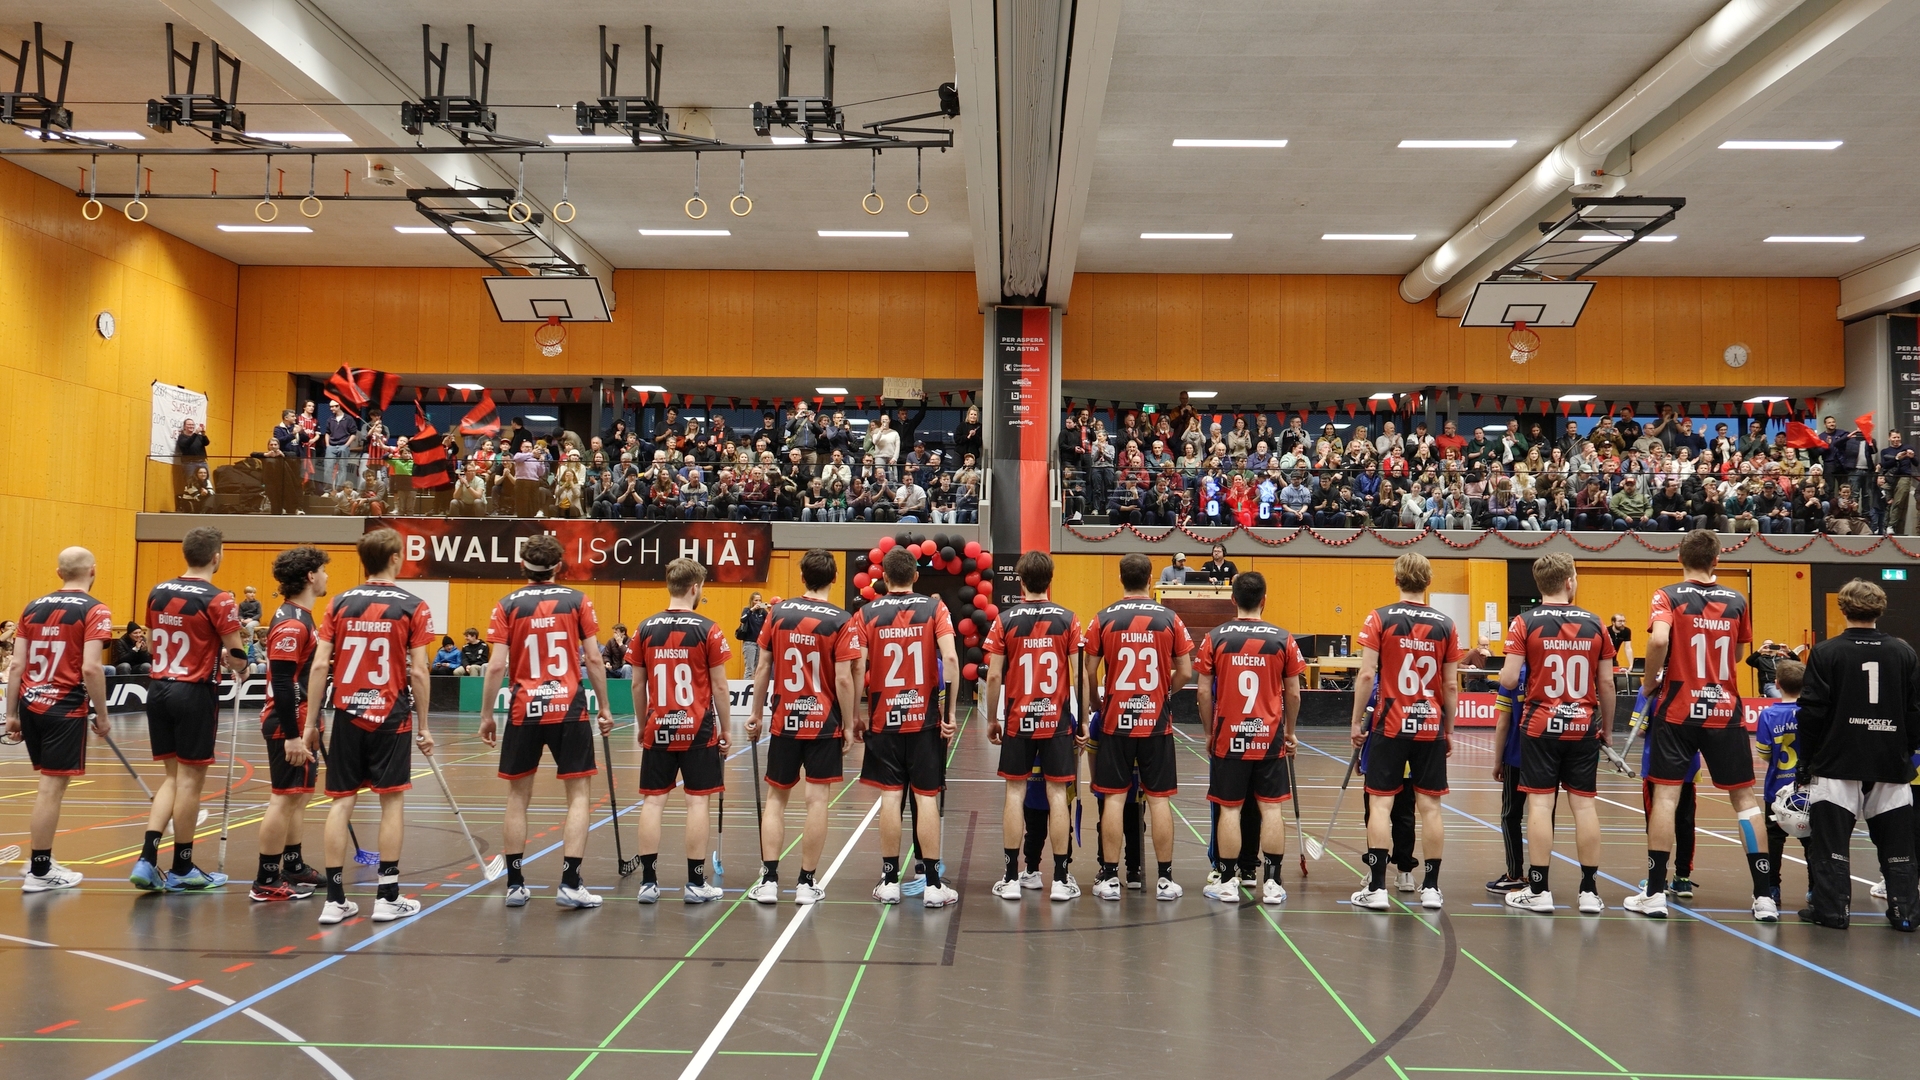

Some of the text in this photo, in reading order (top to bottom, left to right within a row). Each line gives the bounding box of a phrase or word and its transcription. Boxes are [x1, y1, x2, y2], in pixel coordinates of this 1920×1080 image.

[406, 530, 754, 566] BWALD ISCH HIÄ!
[157, 583, 207, 594] UNIHOC
[342, 589, 410, 600] UNIHOC
[510, 588, 572, 600] UNIHOC
[1677, 587, 1736, 598] UNIHOC
[36, 596, 88, 605] UNIHOC
[872, 596, 928, 608] UNIHOC
[781, 602, 840, 616] UNIHOC
[1010, 607, 1064, 617] UNIHOC
[1107, 603, 1165, 613] UNIHOC
[1533, 610, 1591, 618] UNIHOC
[158, 612, 183, 626] BÜRGE
[646, 616, 703, 626] UNIHOC
[1388, 608, 1445, 622] UNIHOC
[531, 617, 556, 628] MUFF
[880, 626, 923, 638] ODERMATT
[1220, 625, 1278, 635] UNIHOC
[789, 633, 816, 646] HOFER
[1024, 638, 1052, 648] FURRER
[1121, 631, 1154, 643] PLUHAŘ
[152, 628, 190, 675] 32
[1543, 640, 1592, 651] BACHMANN
[524, 631, 568, 679] 15
[654, 648, 689, 660] JANSSON
[1691, 634, 1730, 680] 11
[29, 640, 66, 682] 57
[342, 637, 390, 686] 73
[884, 641, 924, 687] 21
[1232, 654, 1265, 667] KUČERA
[784, 647, 822, 693] 31
[1019, 652, 1058, 695] 13
[1115, 647, 1158, 692] 23
[1399, 653, 1437, 697] 62
[1544, 655, 1589, 699] 30
[1862, 662, 1879, 704] 1
[654, 663, 694, 707] 18
[1238, 670, 1259, 714] 9
[543, 703, 569, 712] BÜRGI
[1454, 700, 1495, 718] iliar
[1708, 707, 1733, 717] BÜRGI
[901, 712, 926, 722] BÜRGI
[1134, 718, 1156, 726] BÜRGI
[1849, 718, 1892, 726] UNIHOCKEY
[799, 720, 823, 728] BÜRGI
[1035, 720, 1058, 728] BÜRGI
[1418, 722, 1440, 731] BÜRGI
[1564, 722, 1588, 731] BÜRGI
[670, 732, 695, 741] BÜRGI
[1246, 741, 1270, 750] BÜRGI
[1774, 733, 1798, 770] 3
